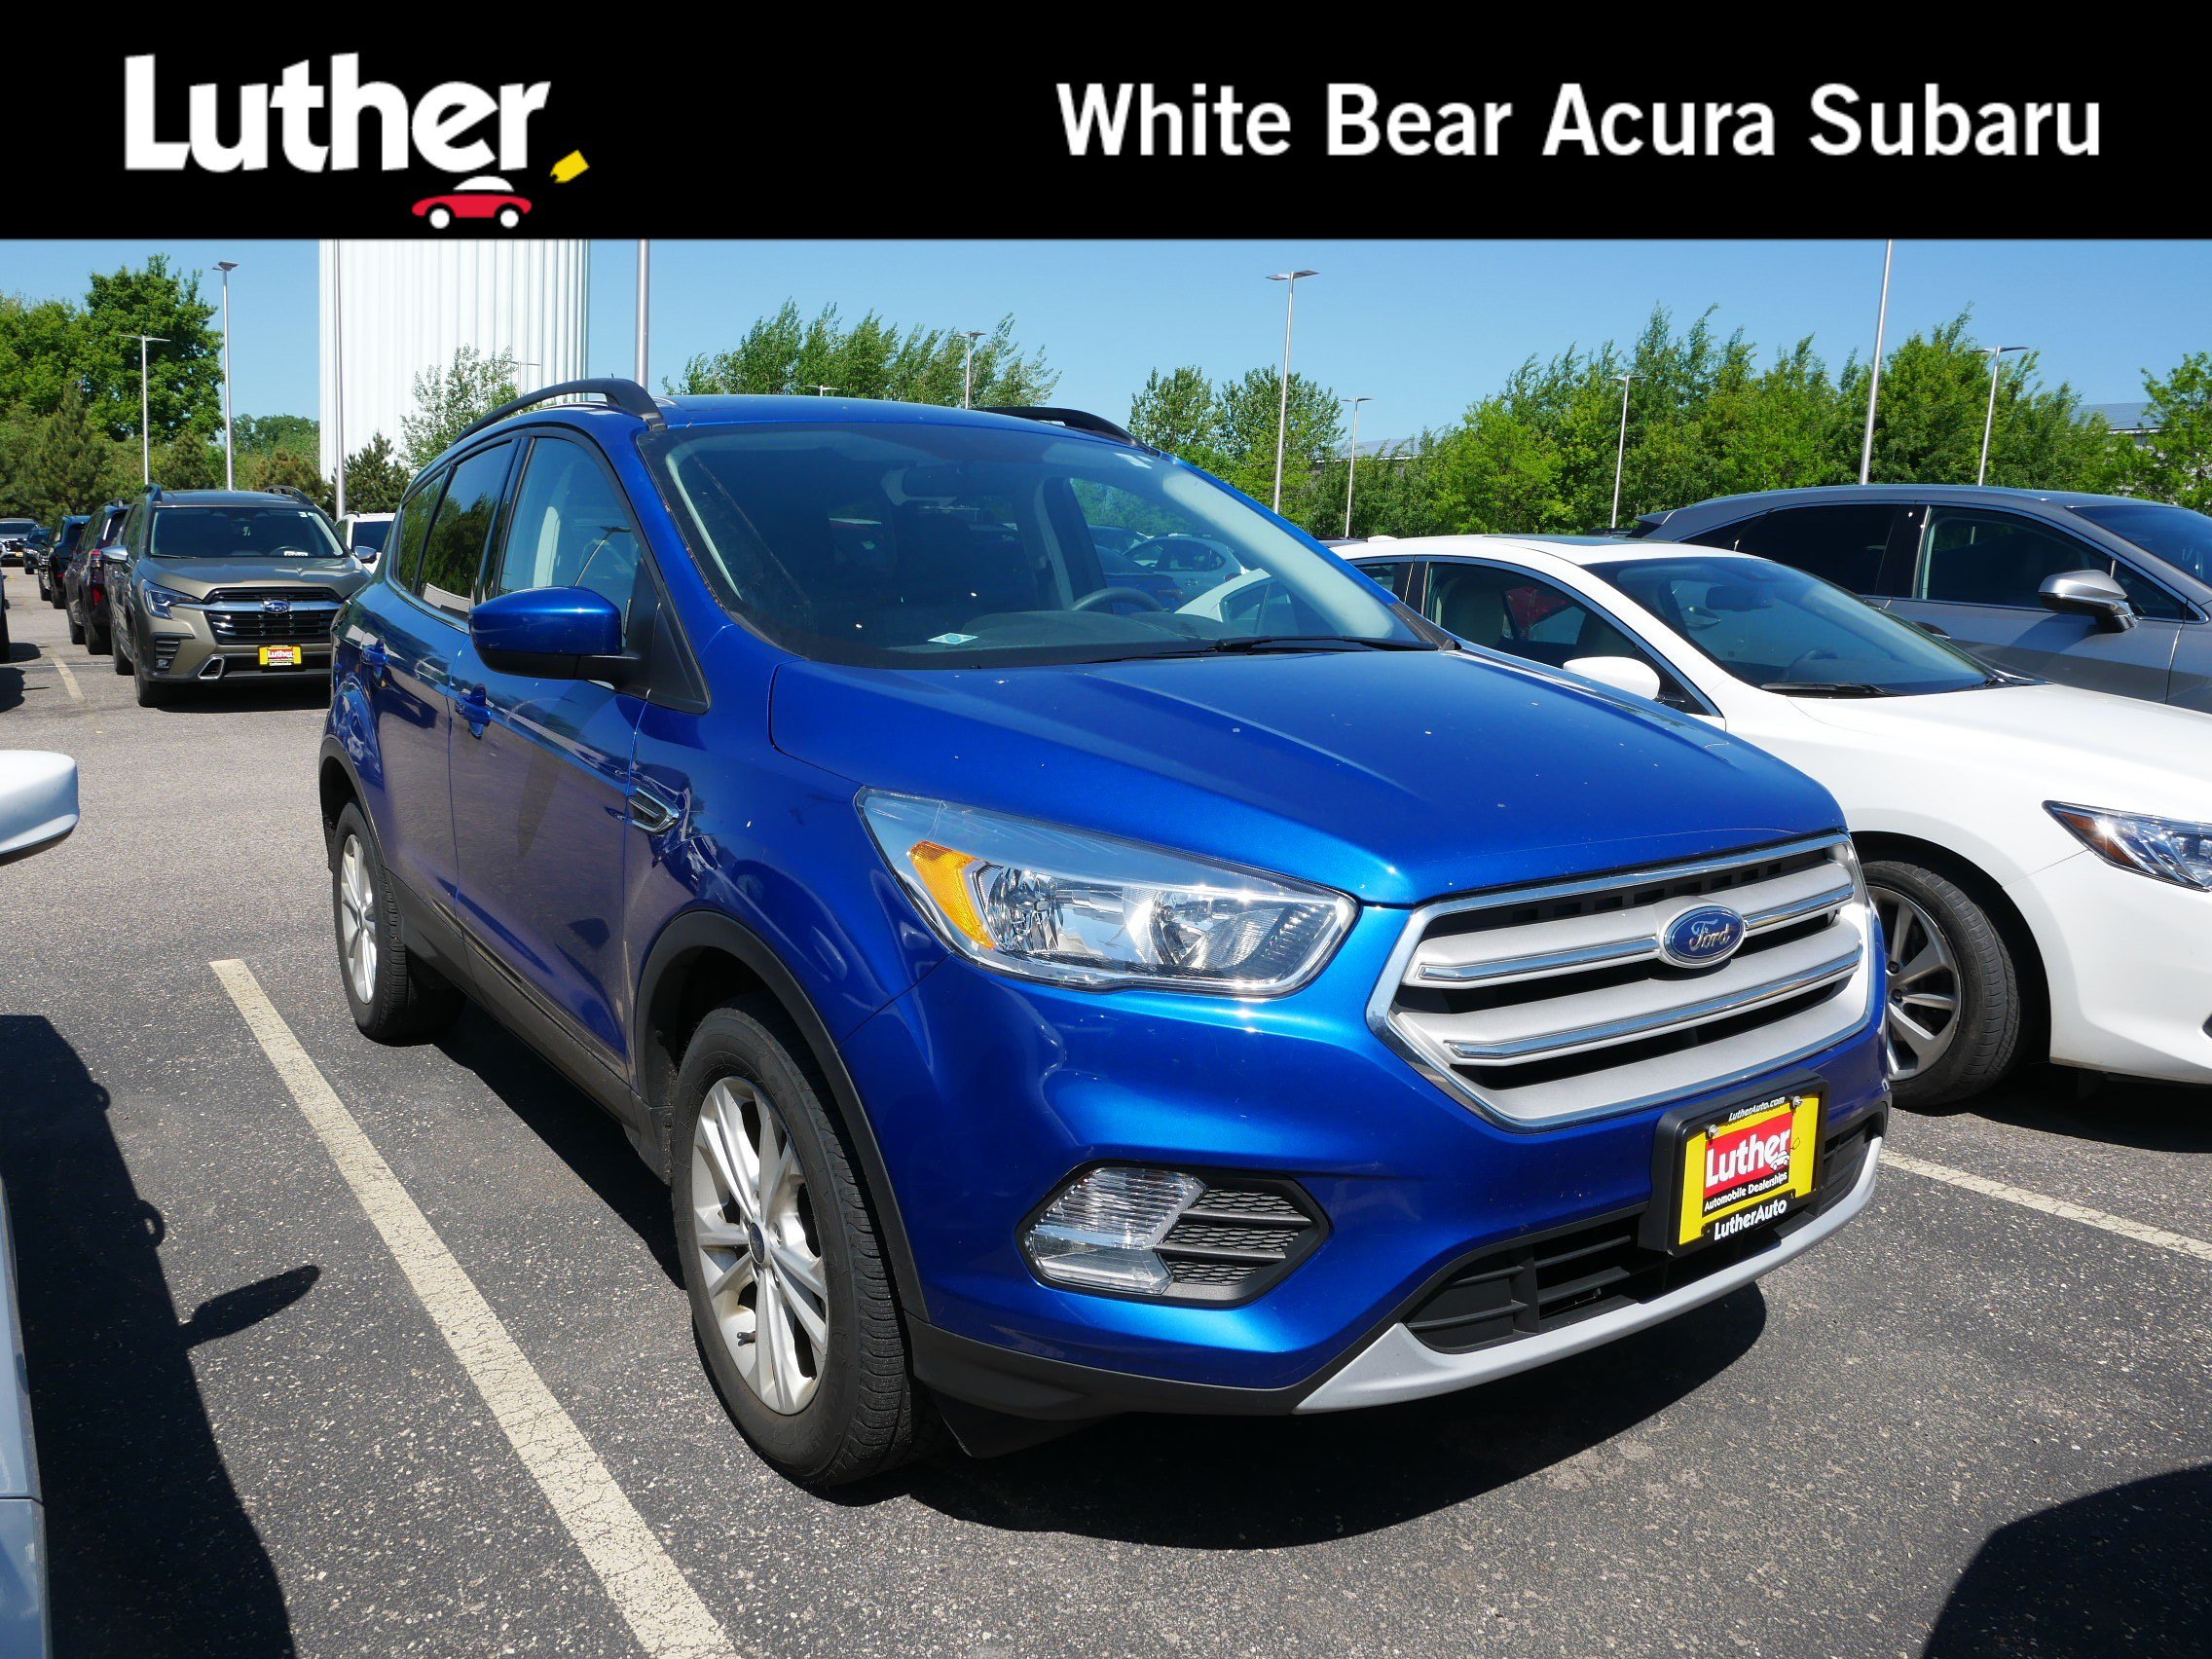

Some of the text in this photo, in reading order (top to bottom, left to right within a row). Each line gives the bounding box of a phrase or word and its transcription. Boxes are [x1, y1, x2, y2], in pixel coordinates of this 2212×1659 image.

[1689, 918, 1731, 952] Ford
[1728, 1096, 1786, 1123] LutherAuto.com
[1706, 1128, 1791, 1189] Luther
[1704, 1171, 1788, 1212] Automobile Dealerships
[1714, 1198, 1788, 1241] LutherAuto
